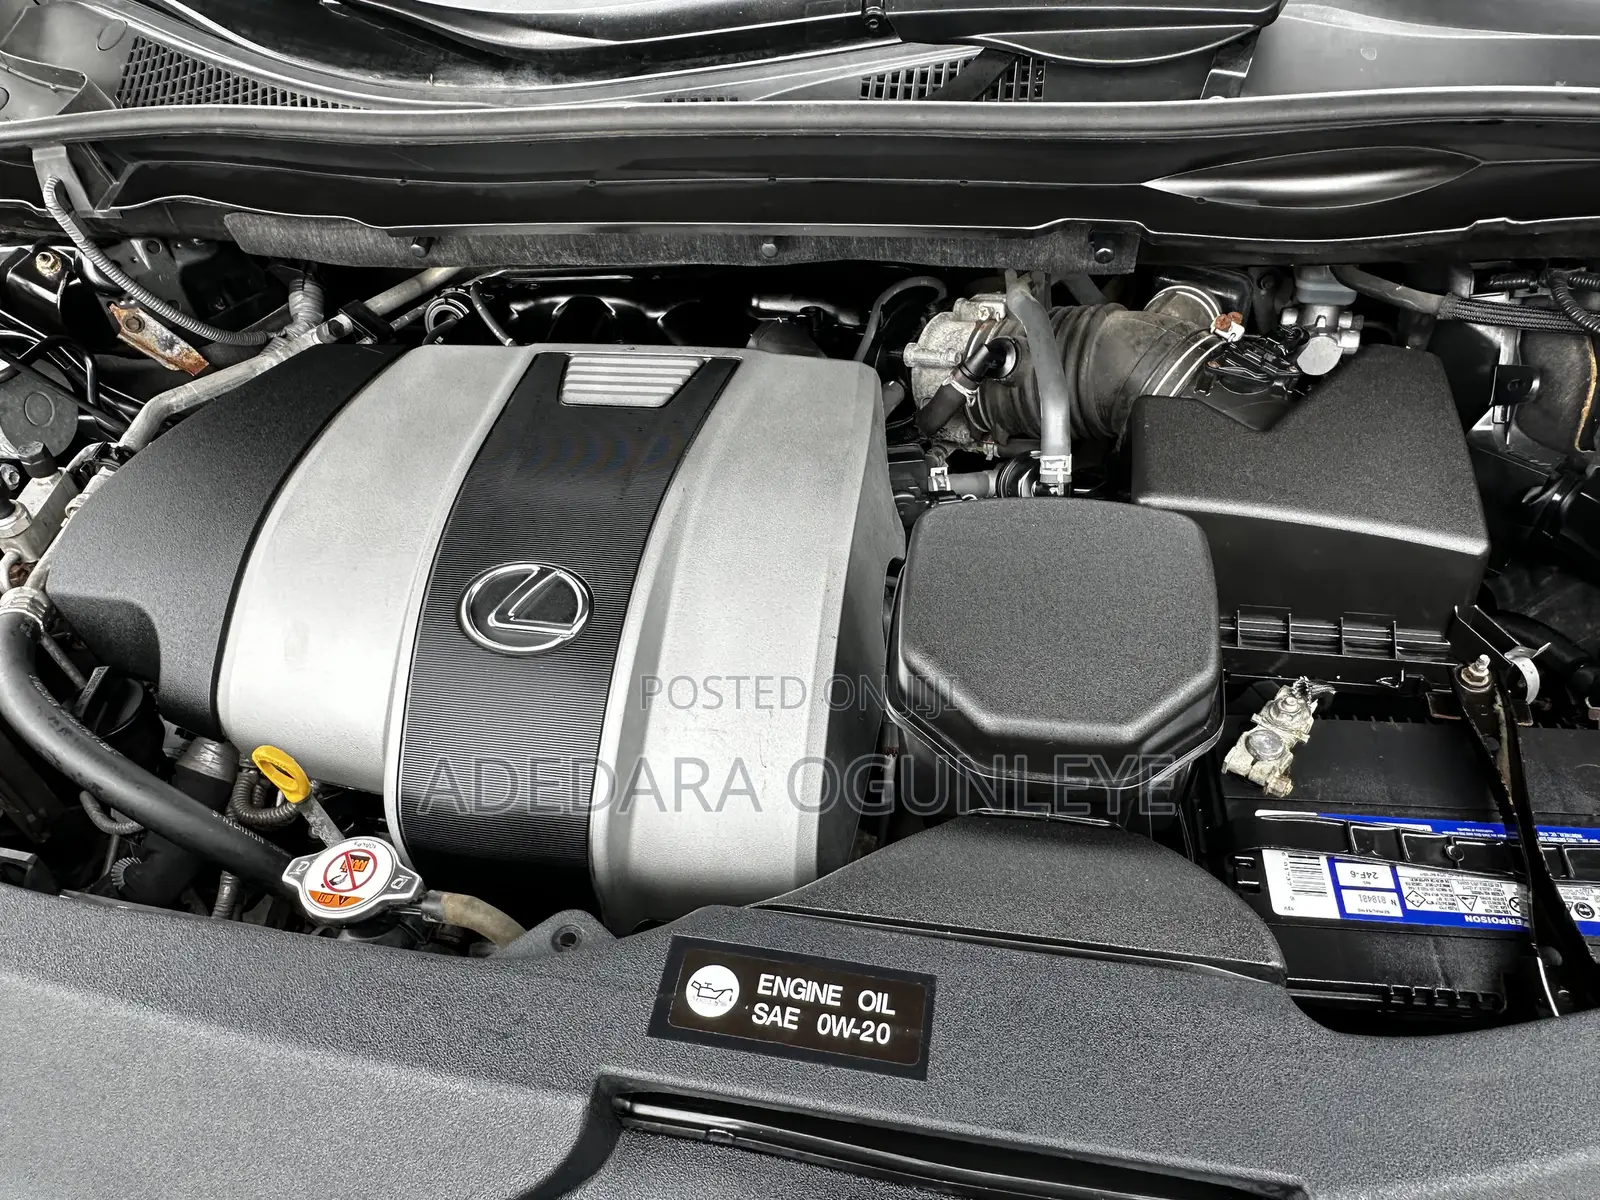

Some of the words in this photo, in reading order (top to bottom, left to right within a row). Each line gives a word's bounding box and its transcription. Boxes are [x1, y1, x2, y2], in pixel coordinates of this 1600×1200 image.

[1349, 869, 1379, 880] 24F-6
[1464, 914, 1523, 926] ER/POISON
[756, 973, 843, 1007] ENGINE
[857, 989, 896, 1016] OIL
[751, 1002, 801, 1030] SAE
[816, 1013, 891, 1045] 0W-20
